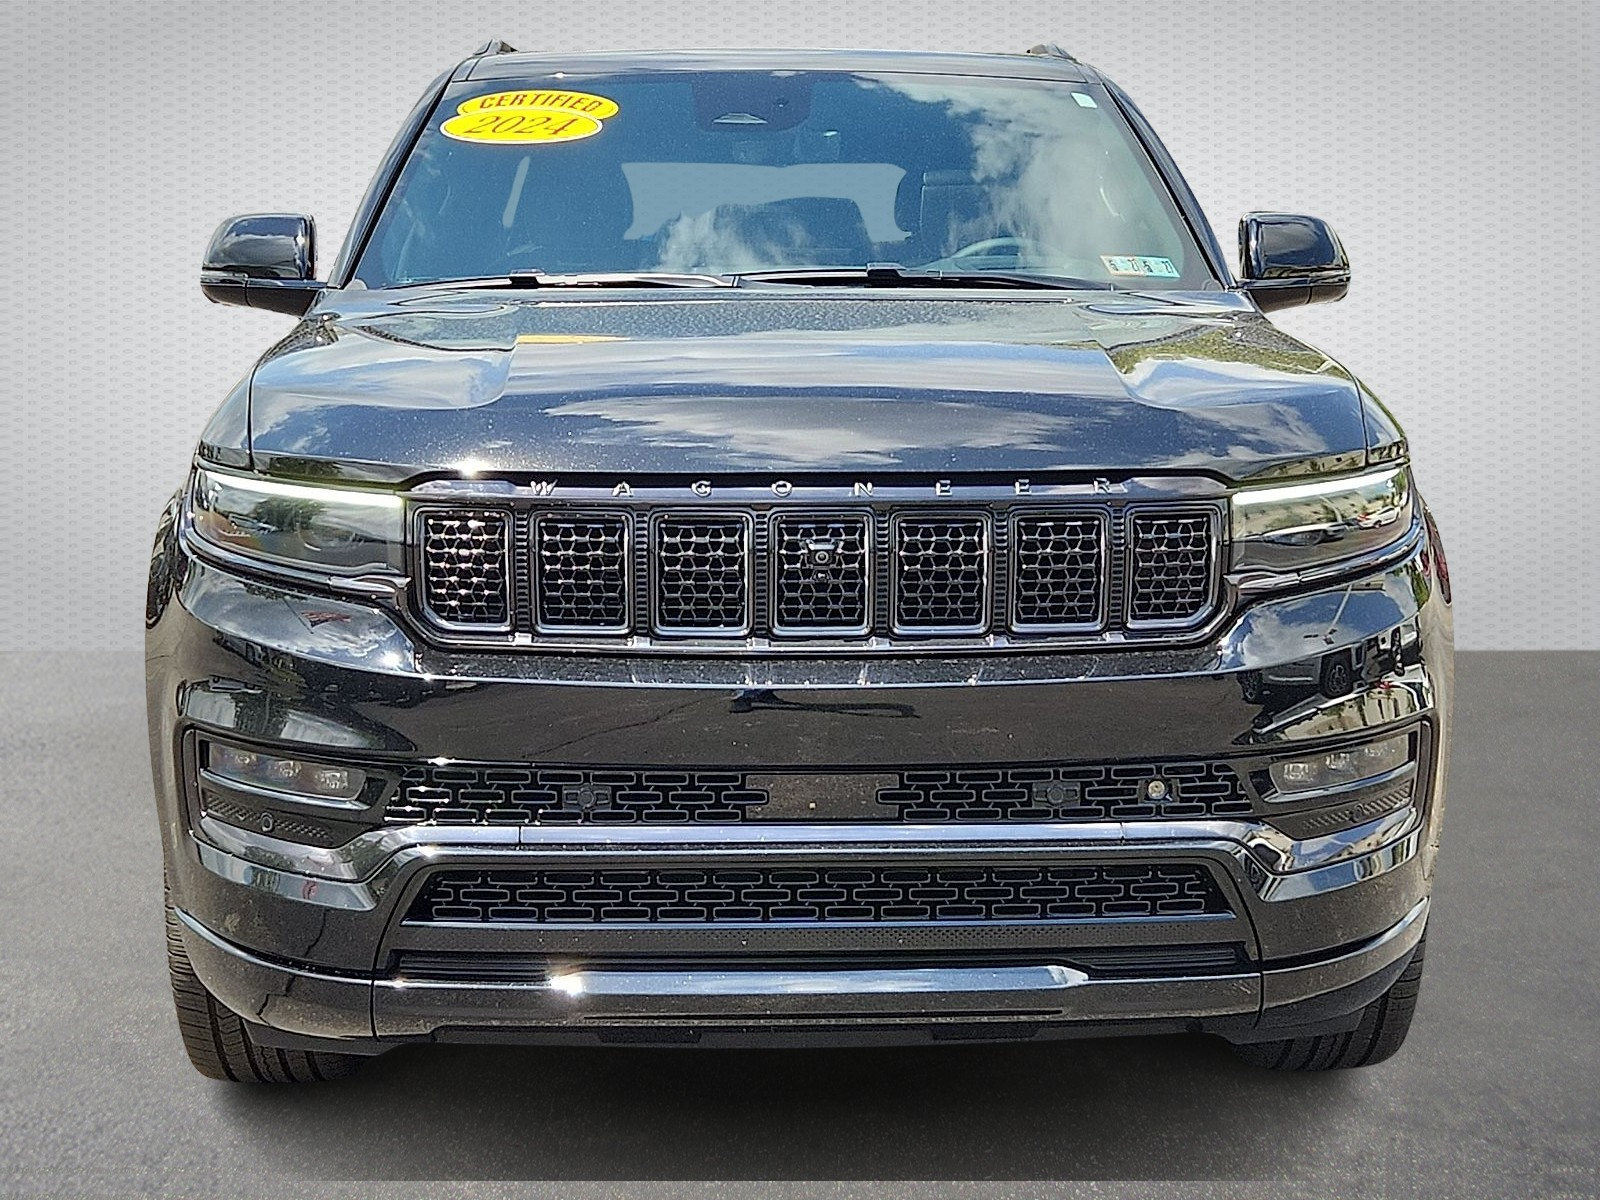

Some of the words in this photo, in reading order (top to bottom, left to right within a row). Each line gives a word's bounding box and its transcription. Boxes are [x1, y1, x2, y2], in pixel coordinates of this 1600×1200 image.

[479, 93, 603, 113] CERTIFIED
[465, 115, 579, 136] 2024
[530, 477, 1112, 497] WAGONEER
